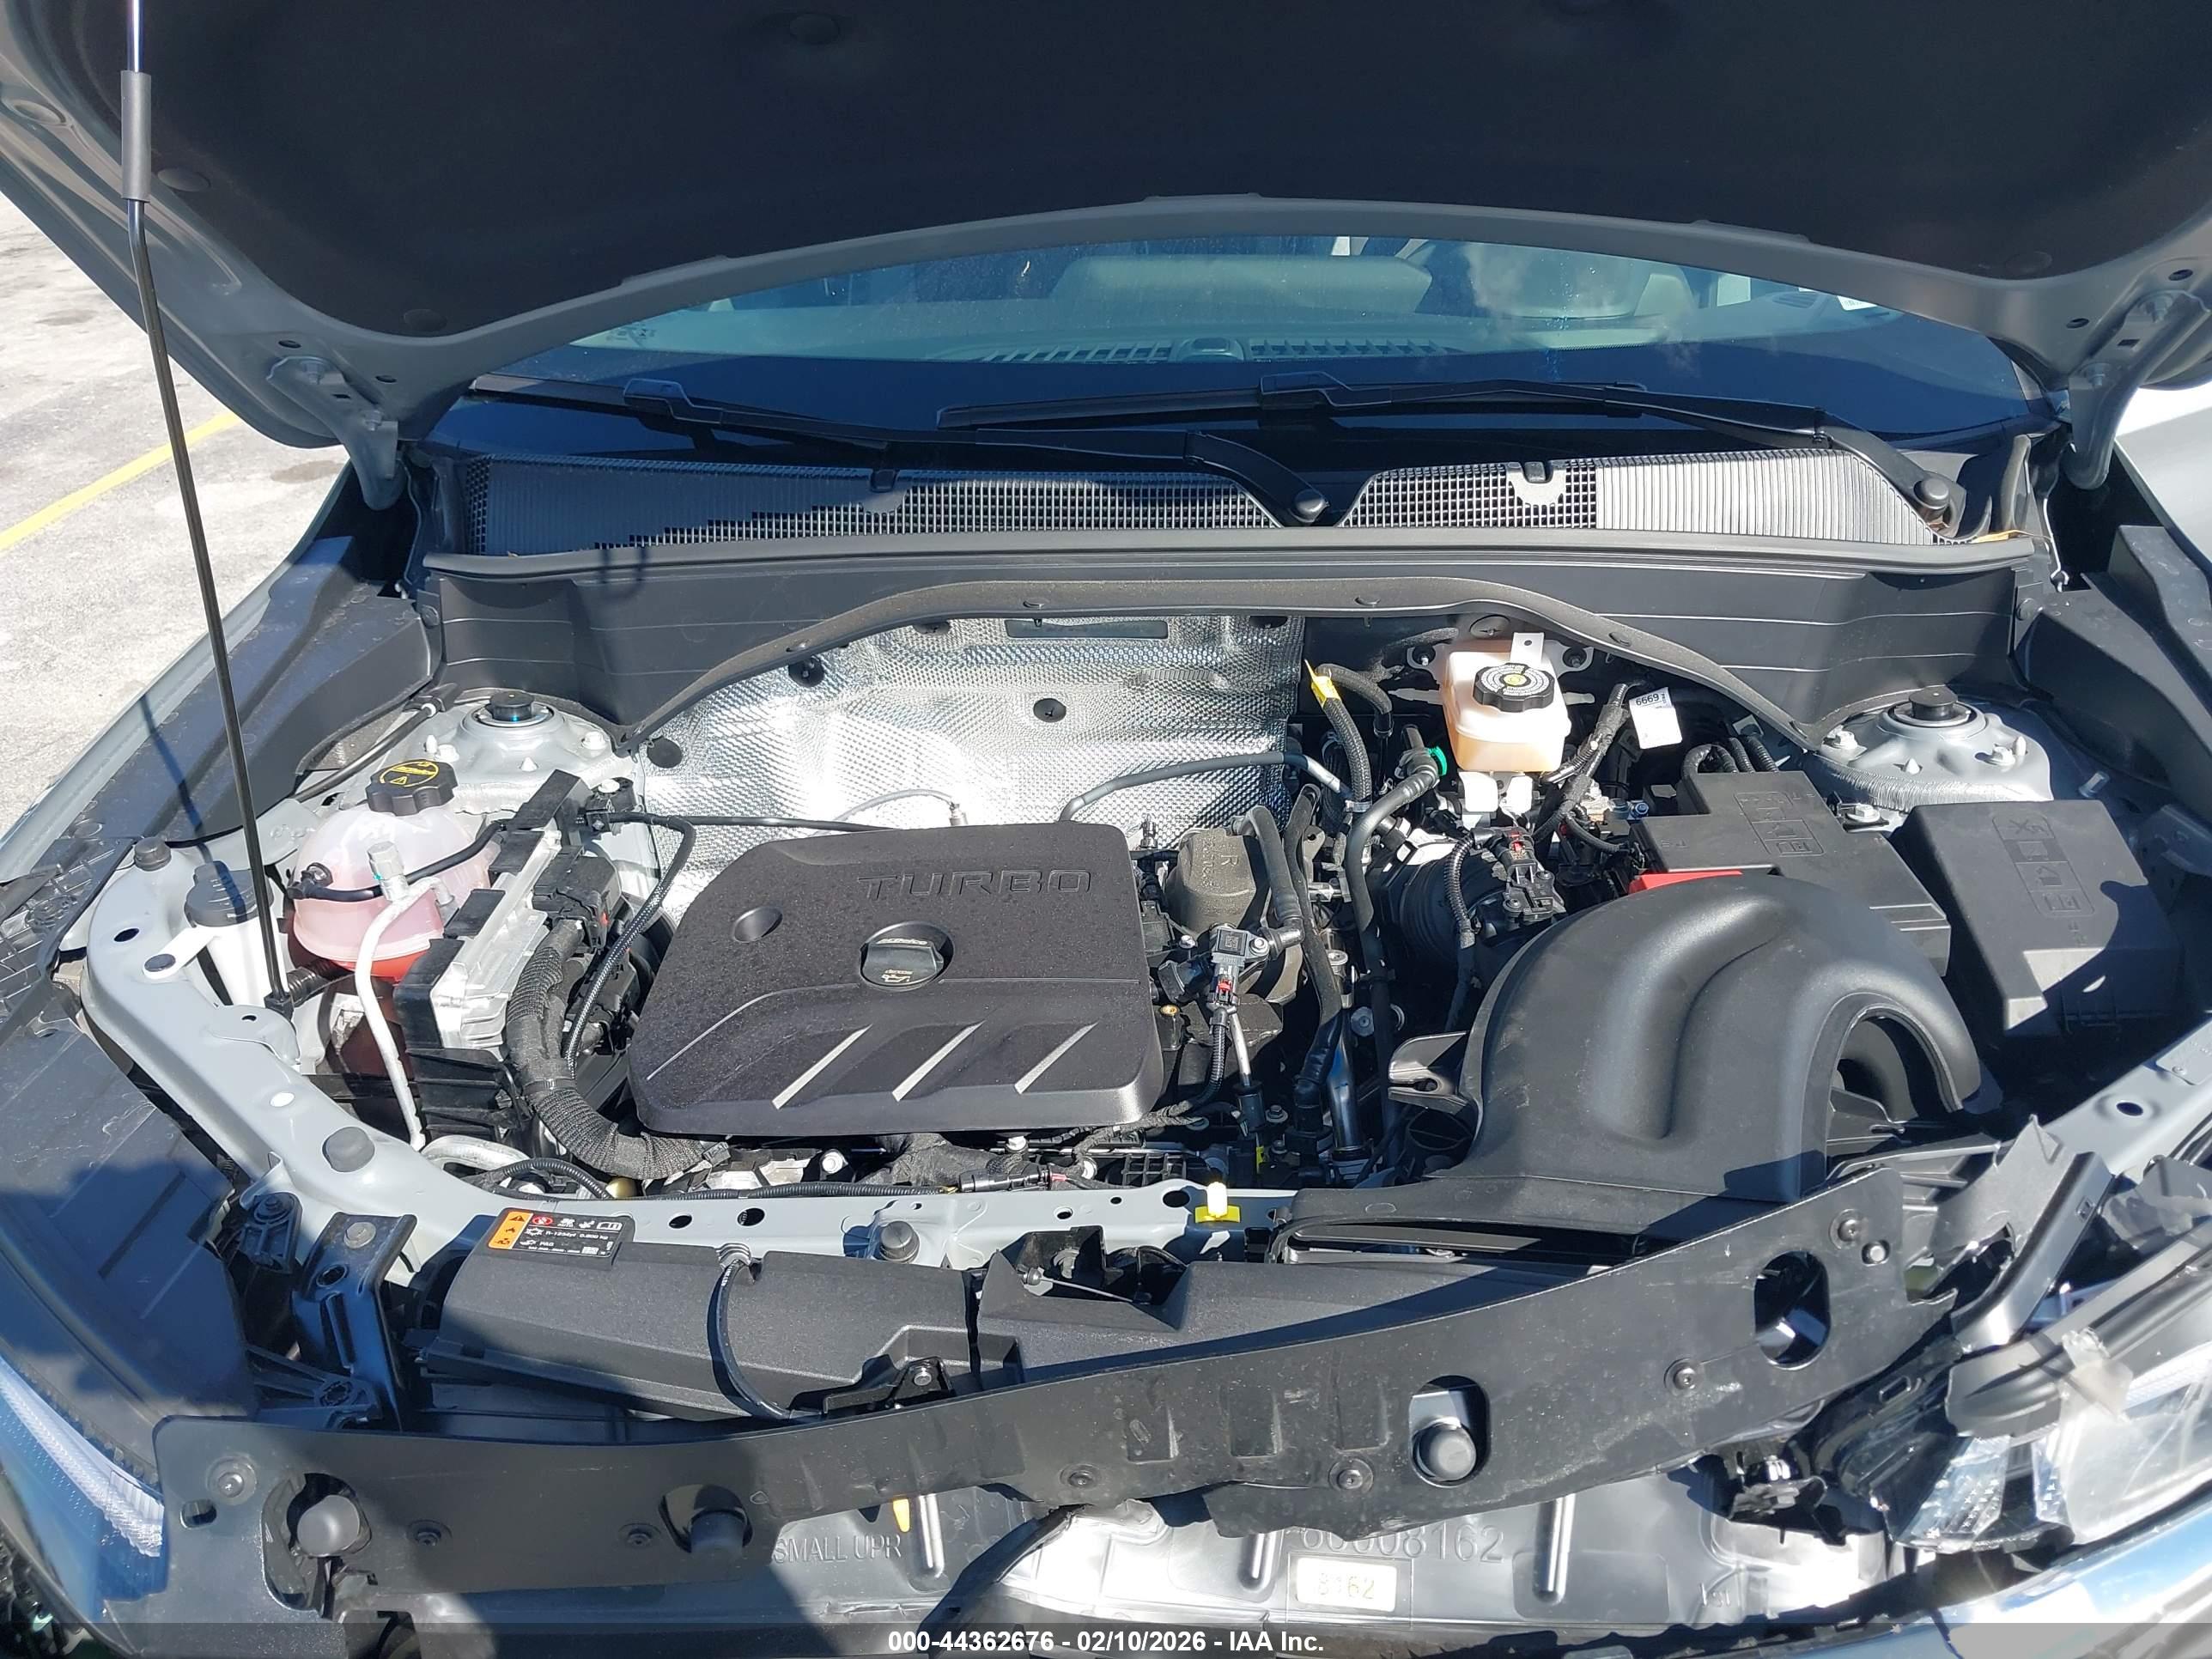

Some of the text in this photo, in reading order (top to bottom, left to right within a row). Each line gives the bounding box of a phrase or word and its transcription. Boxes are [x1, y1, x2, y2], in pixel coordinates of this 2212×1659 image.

[858, 869, 1091, 900] TURBO
[772, 1534, 902, 1564] SMALL UPR
